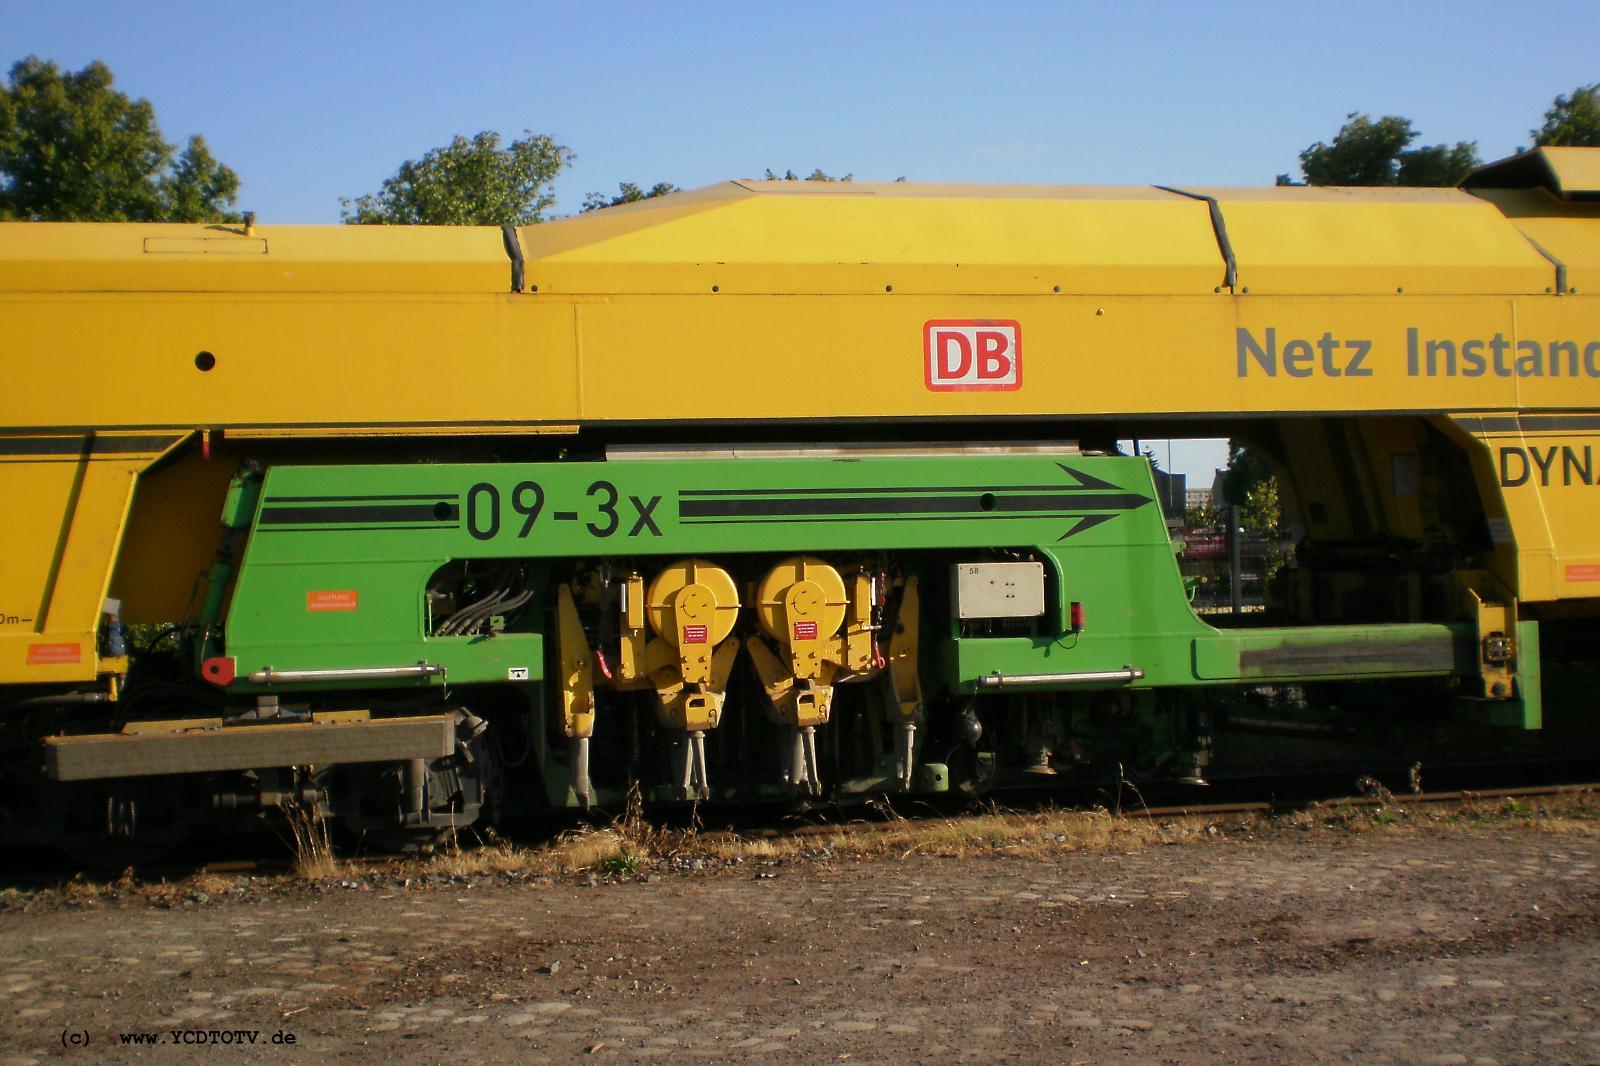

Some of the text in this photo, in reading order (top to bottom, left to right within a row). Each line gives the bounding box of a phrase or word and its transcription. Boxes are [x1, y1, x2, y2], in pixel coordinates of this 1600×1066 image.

[937, 331, 1011, 379] DB
[1236, 327, 1374, 378] Netz
[1500, 445, 1600, 487] DYN
[467, 480, 664, 541] 09-3x
